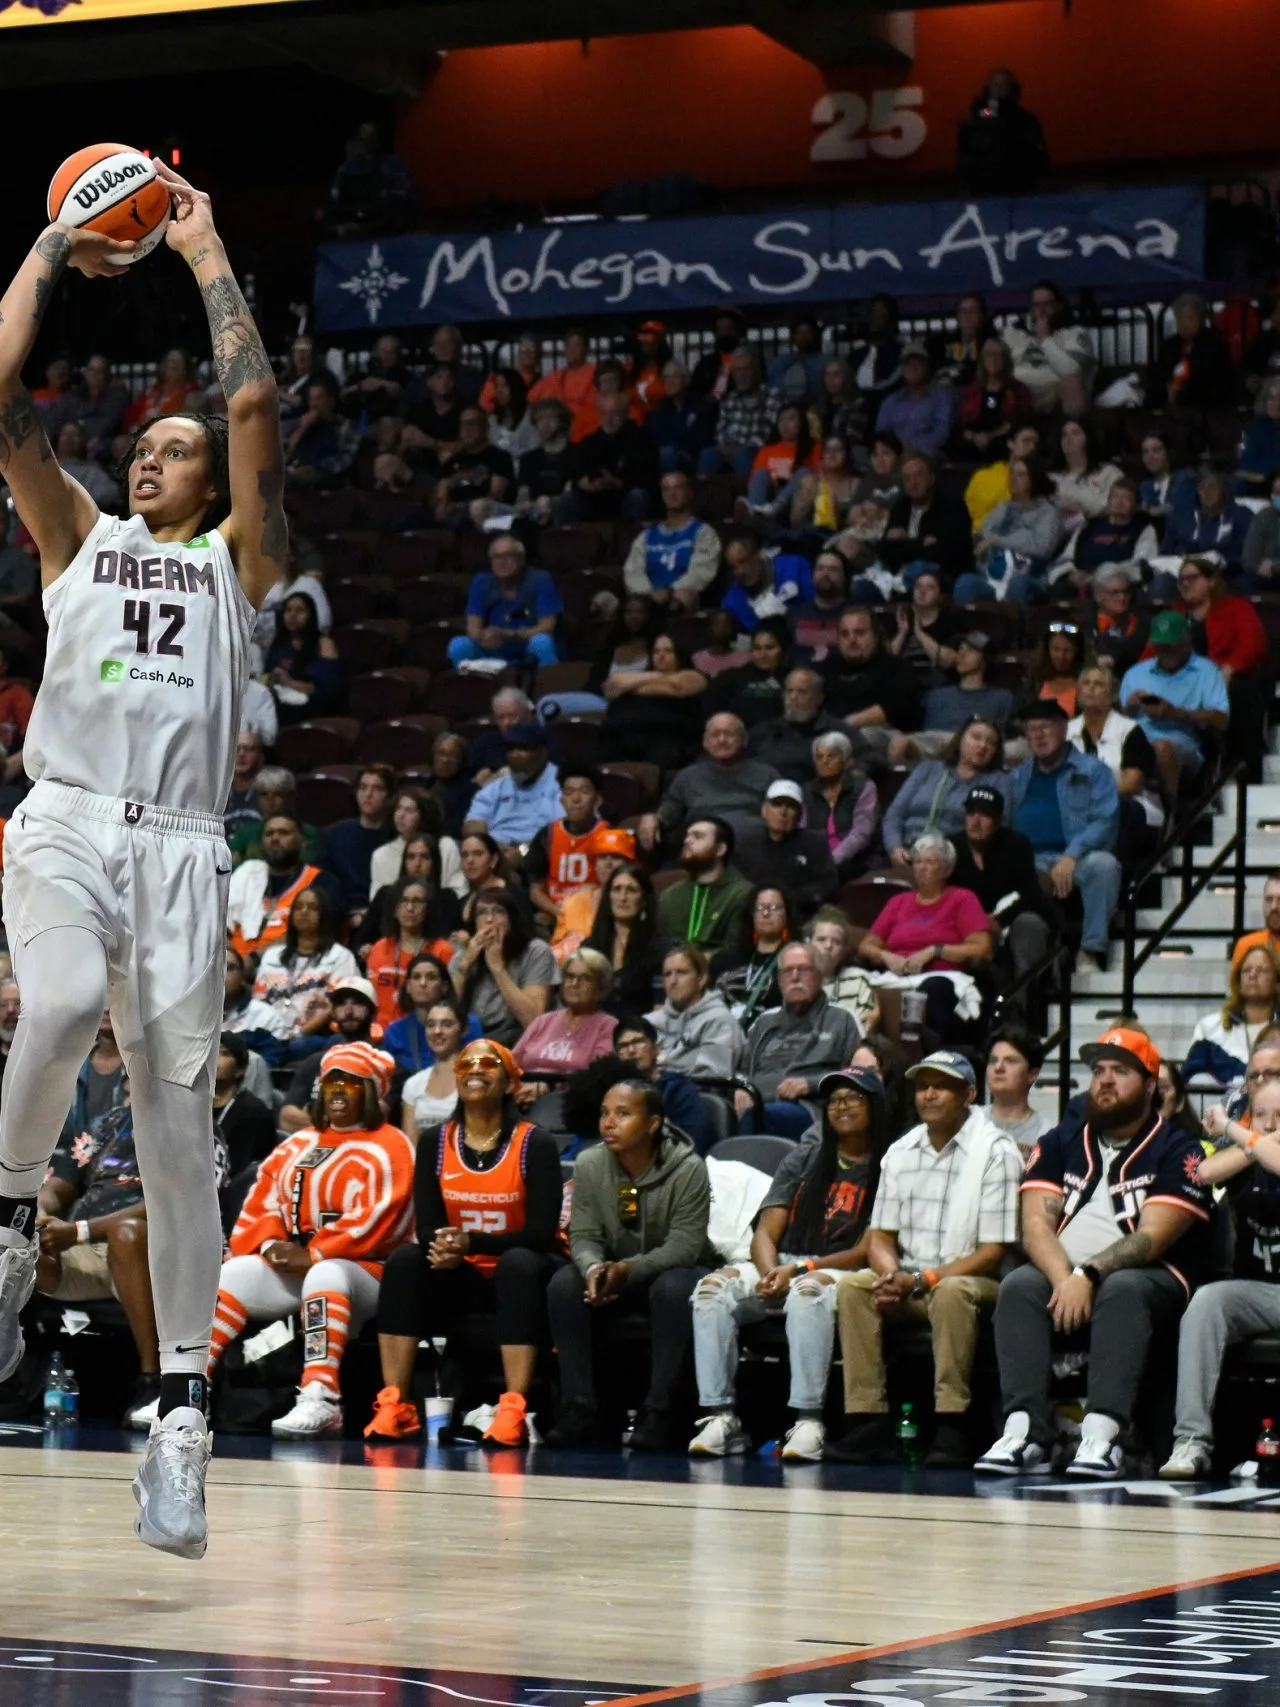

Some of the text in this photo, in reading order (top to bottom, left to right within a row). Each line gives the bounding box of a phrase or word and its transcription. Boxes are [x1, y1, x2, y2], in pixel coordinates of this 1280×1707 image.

[810, 87, 927, 161] 25
[73, 162, 148, 209] Wilson
[419, 204, 1179, 316] Mohegan Sun Arena
[93, 550, 216, 596] DREAM
[123, 600, 186, 658] 42
[129, 668, 194, 688] Cash App
[559, 853, 589, 883] 10
